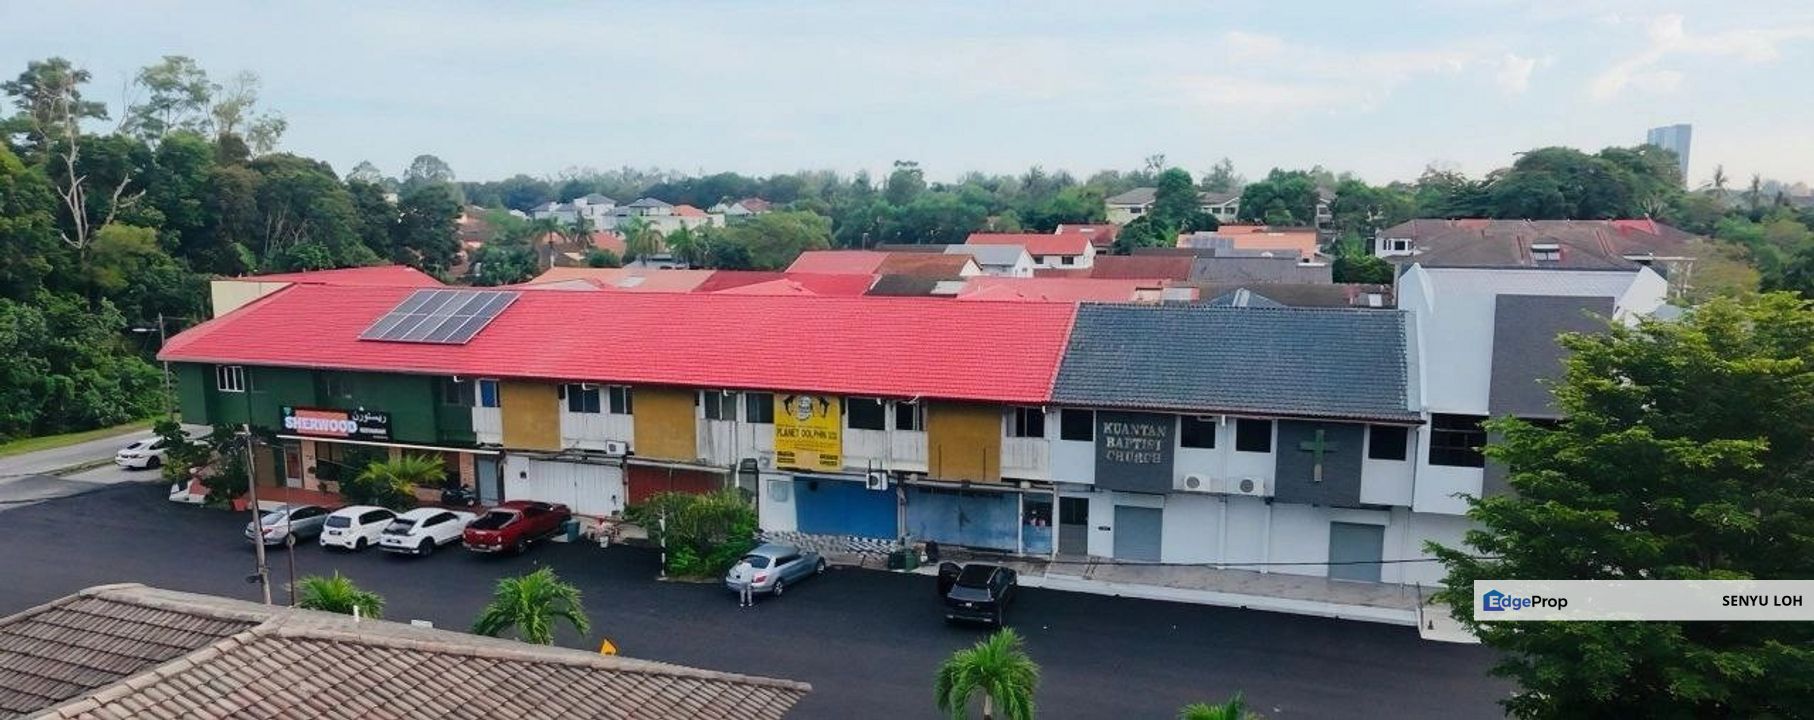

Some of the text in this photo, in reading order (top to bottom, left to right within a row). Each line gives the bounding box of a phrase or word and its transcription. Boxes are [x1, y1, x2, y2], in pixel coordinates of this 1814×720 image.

[285, 416, 358, 433] SHERWOOD
[1103, 422, 1166, 437] KUANTAN
[776, 428, 799, 437] PLANET
[801, 429, 827, 439] DOLPHIN
[1106, 450, 1161, 464] CHURCH
